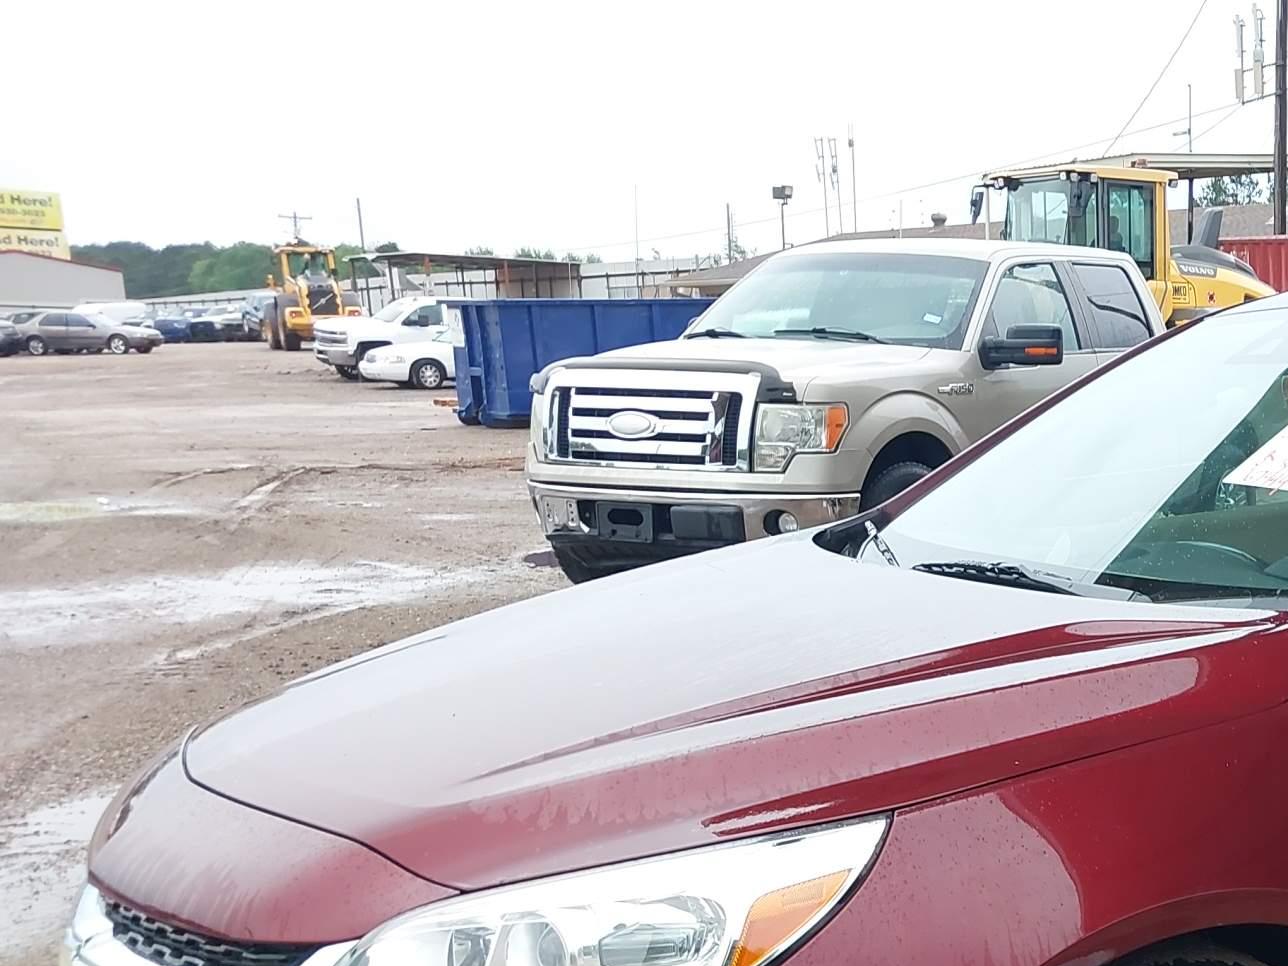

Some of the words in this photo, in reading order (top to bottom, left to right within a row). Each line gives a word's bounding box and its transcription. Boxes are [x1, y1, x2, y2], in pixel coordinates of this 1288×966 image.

[10, 194, 53, 208] Here!
[16, 235, 59, 248] Here!
[1179, 264, 1215, 275] VOLVO
